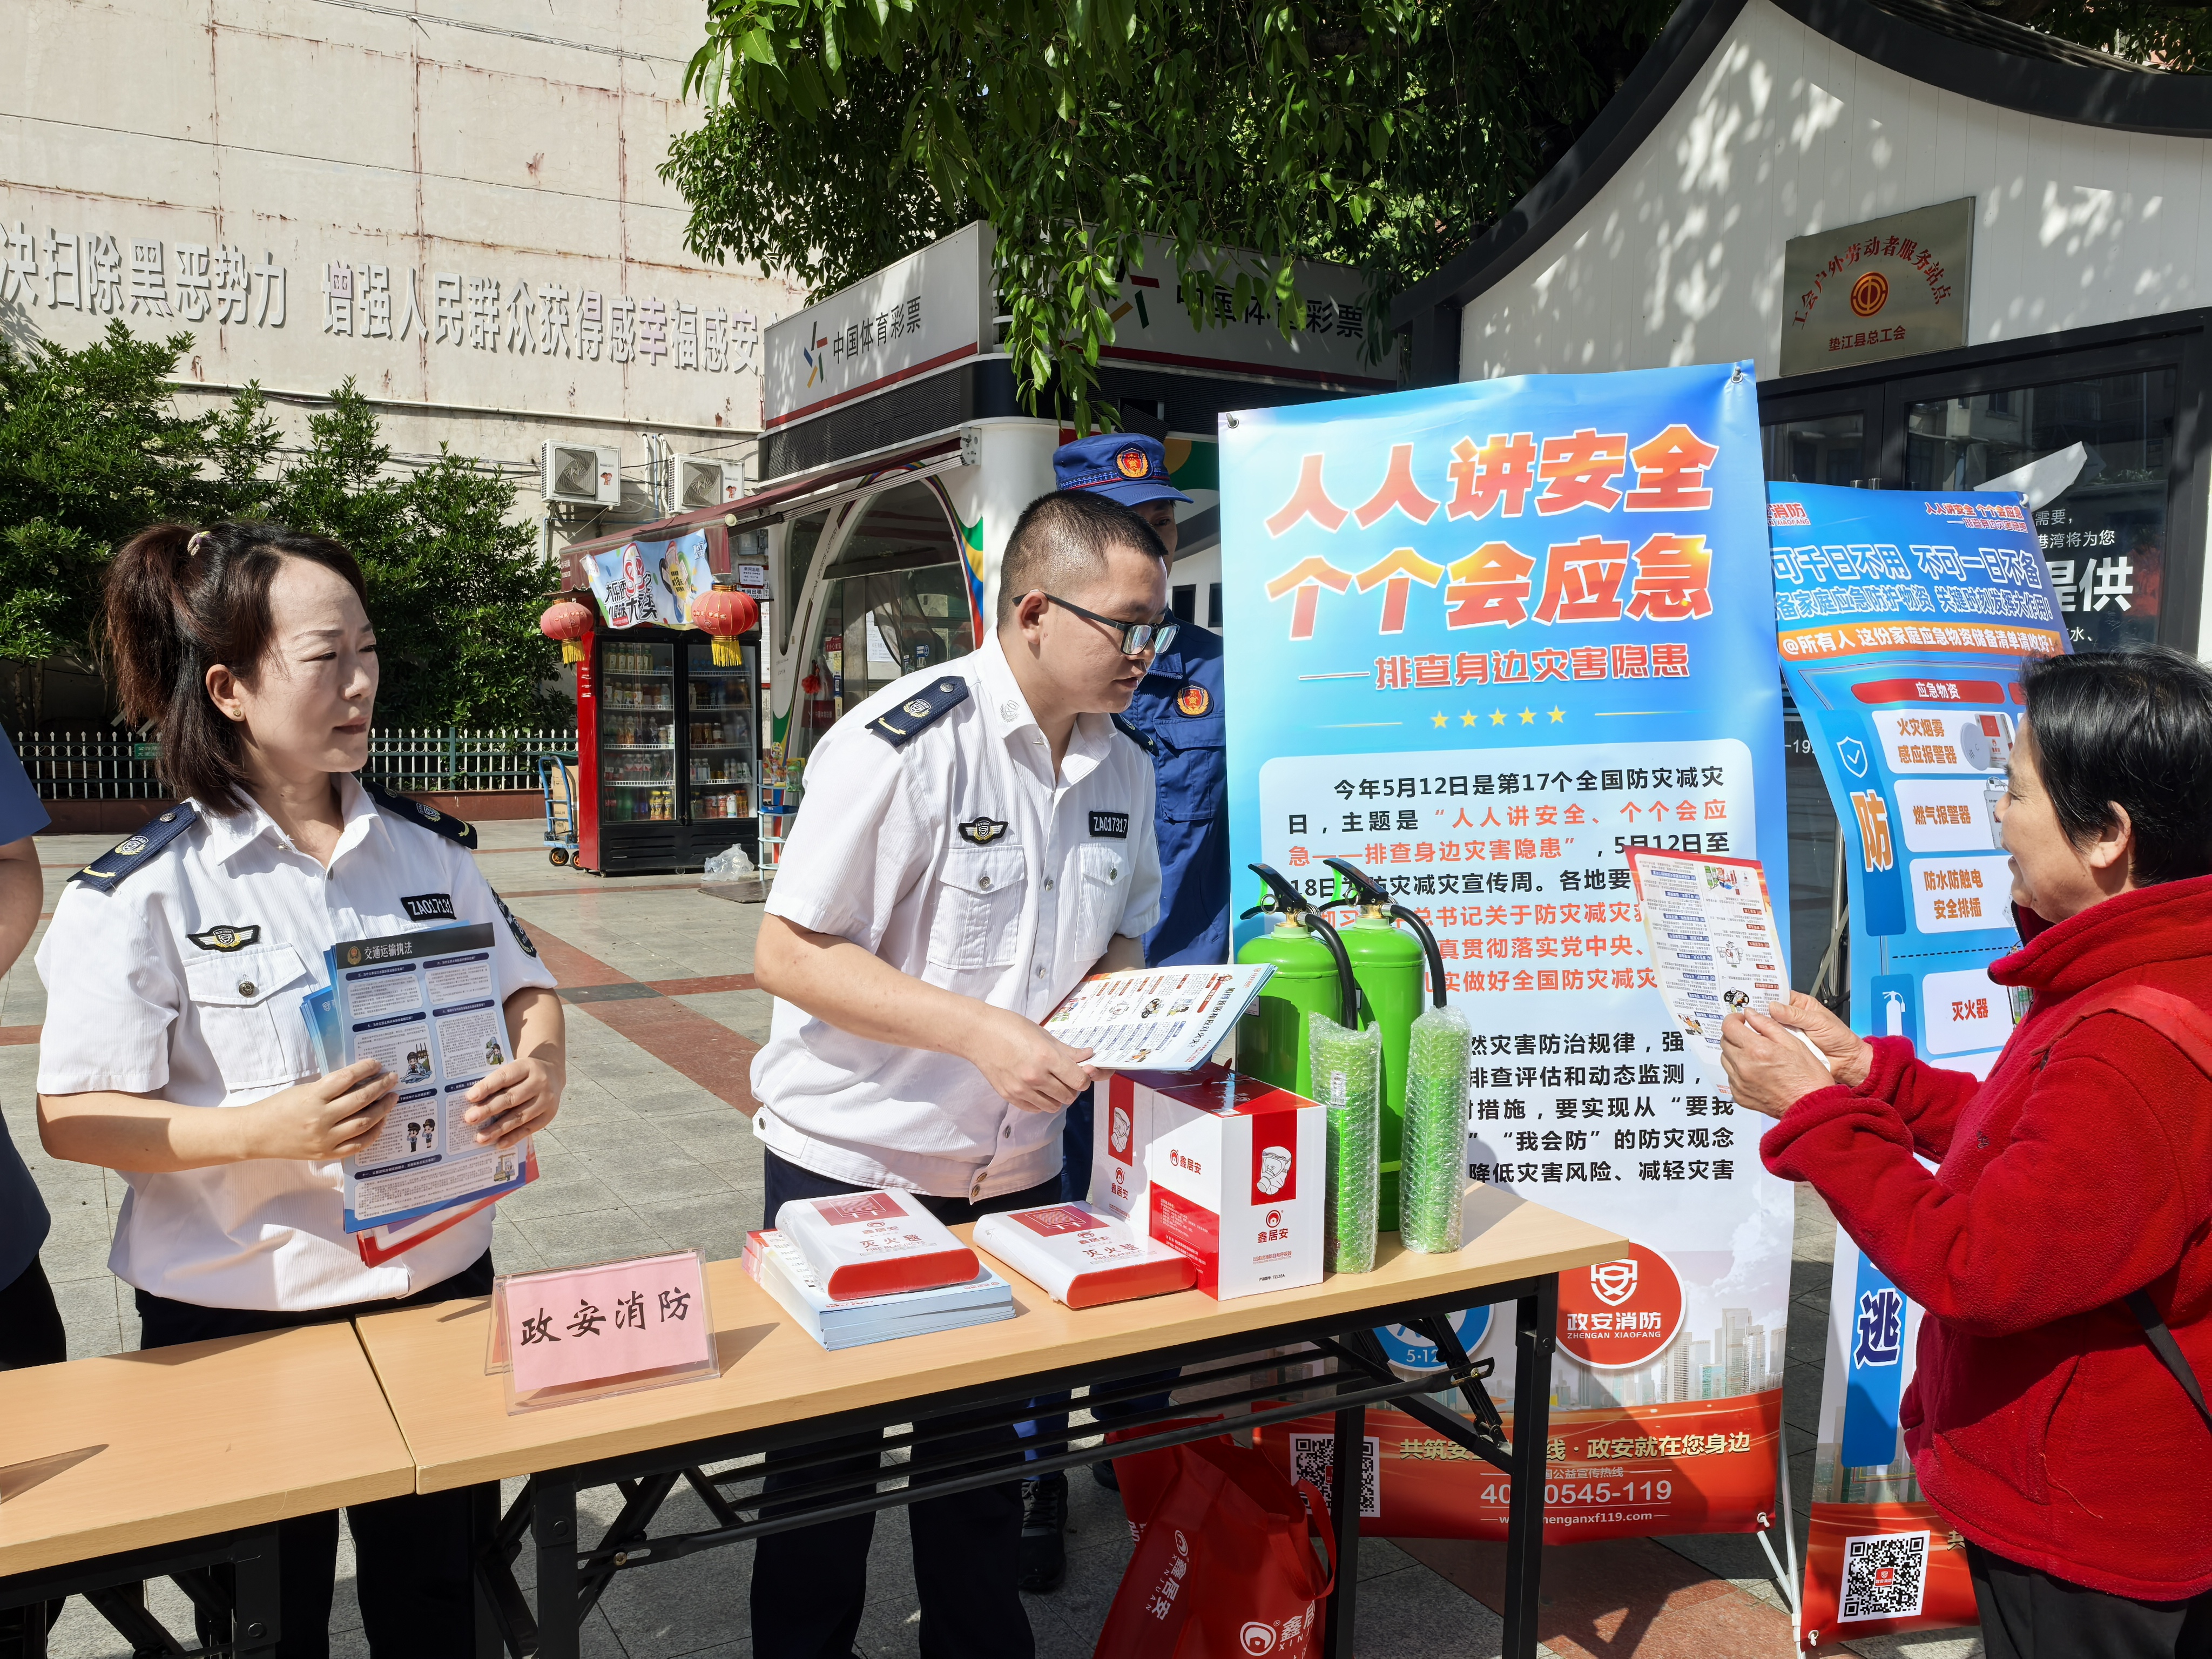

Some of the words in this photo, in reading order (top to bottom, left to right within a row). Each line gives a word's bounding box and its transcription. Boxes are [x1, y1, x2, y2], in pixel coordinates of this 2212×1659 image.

[1792, 235, 1951, 330] 工会户外劳动者服务站点
[323, 260, 758, 376] 增强人民群众获得感幸福感安
[832, 295, 921, 365] 中国体育彩票
[1829, 325, 1906, 352] 垫江县总工会
[1264, 423, 1719, 538] 人人讲安全
[1924, 502, 1977, 517] 人人讲安全
[1976, 504, 2024, 520] 个个会应急
[1909, 544, 2042, 589] 不可一日不备
[1265, 532, 1714, 640] 个个会应急
[1775, 584, 1936, 621] 备家庭应急防护物资
[1782, 630, 1856, 655] @所有人
[2068, 626, 2092, 642] 水、
[1916, 681, 1961, 700] 应急物资
[1896, 718, 1945, 738] 火灾烟雾
[1897, 745, 1957, 765] 感应报警器
[1334, 764, 1725, 801] 今年5月12日是第17个全国防灾减灾
[1093, 817, 1128, 834] ZA017317
[1912, 805, 1971, 825] 燃气报警器
[1850, 790, 1894, 873] 防
[1923, 869, 1984, 890] 防水防触电
[408, 899, 453, 915] ZA017131
[1933, 897, 1982, 919] 安全排插
[364, 941, 413, 961] 交通运输执法
[1951, 998, 1989, 1022] 灭火器
[1179, 1154, 1202, 1176] 鑫居安
[1469, 1159, 1735, 1184] 降低灾害风险、减轻灾害
[1111, 1182, 1128, 1201] 鑫居安
[859, 1234, 922, 1249] 灭火毯
[862, 1226, 899, 1235] 鑫居安
[1257, 1228, 1289, 1244] 鑫居安
[866, 1244, 885, 1252] FIRE
[1082, 1243, 1139, 1258] 灭火毯
[521, 1286, 691, 1346] 政安消防
[1567, 1312, 1662, 1331] 政安消防
[1567, 1331, 1610, 1340] ZHENGAN
[1614, 1330, 1662, 1339] XIAOFANG
[1855, 1288, 1903, 1370] 逃
[1480, 1480, 1672, 1504] 400545-119
[1152, 1556, 1187, 1620] 鑫居安
